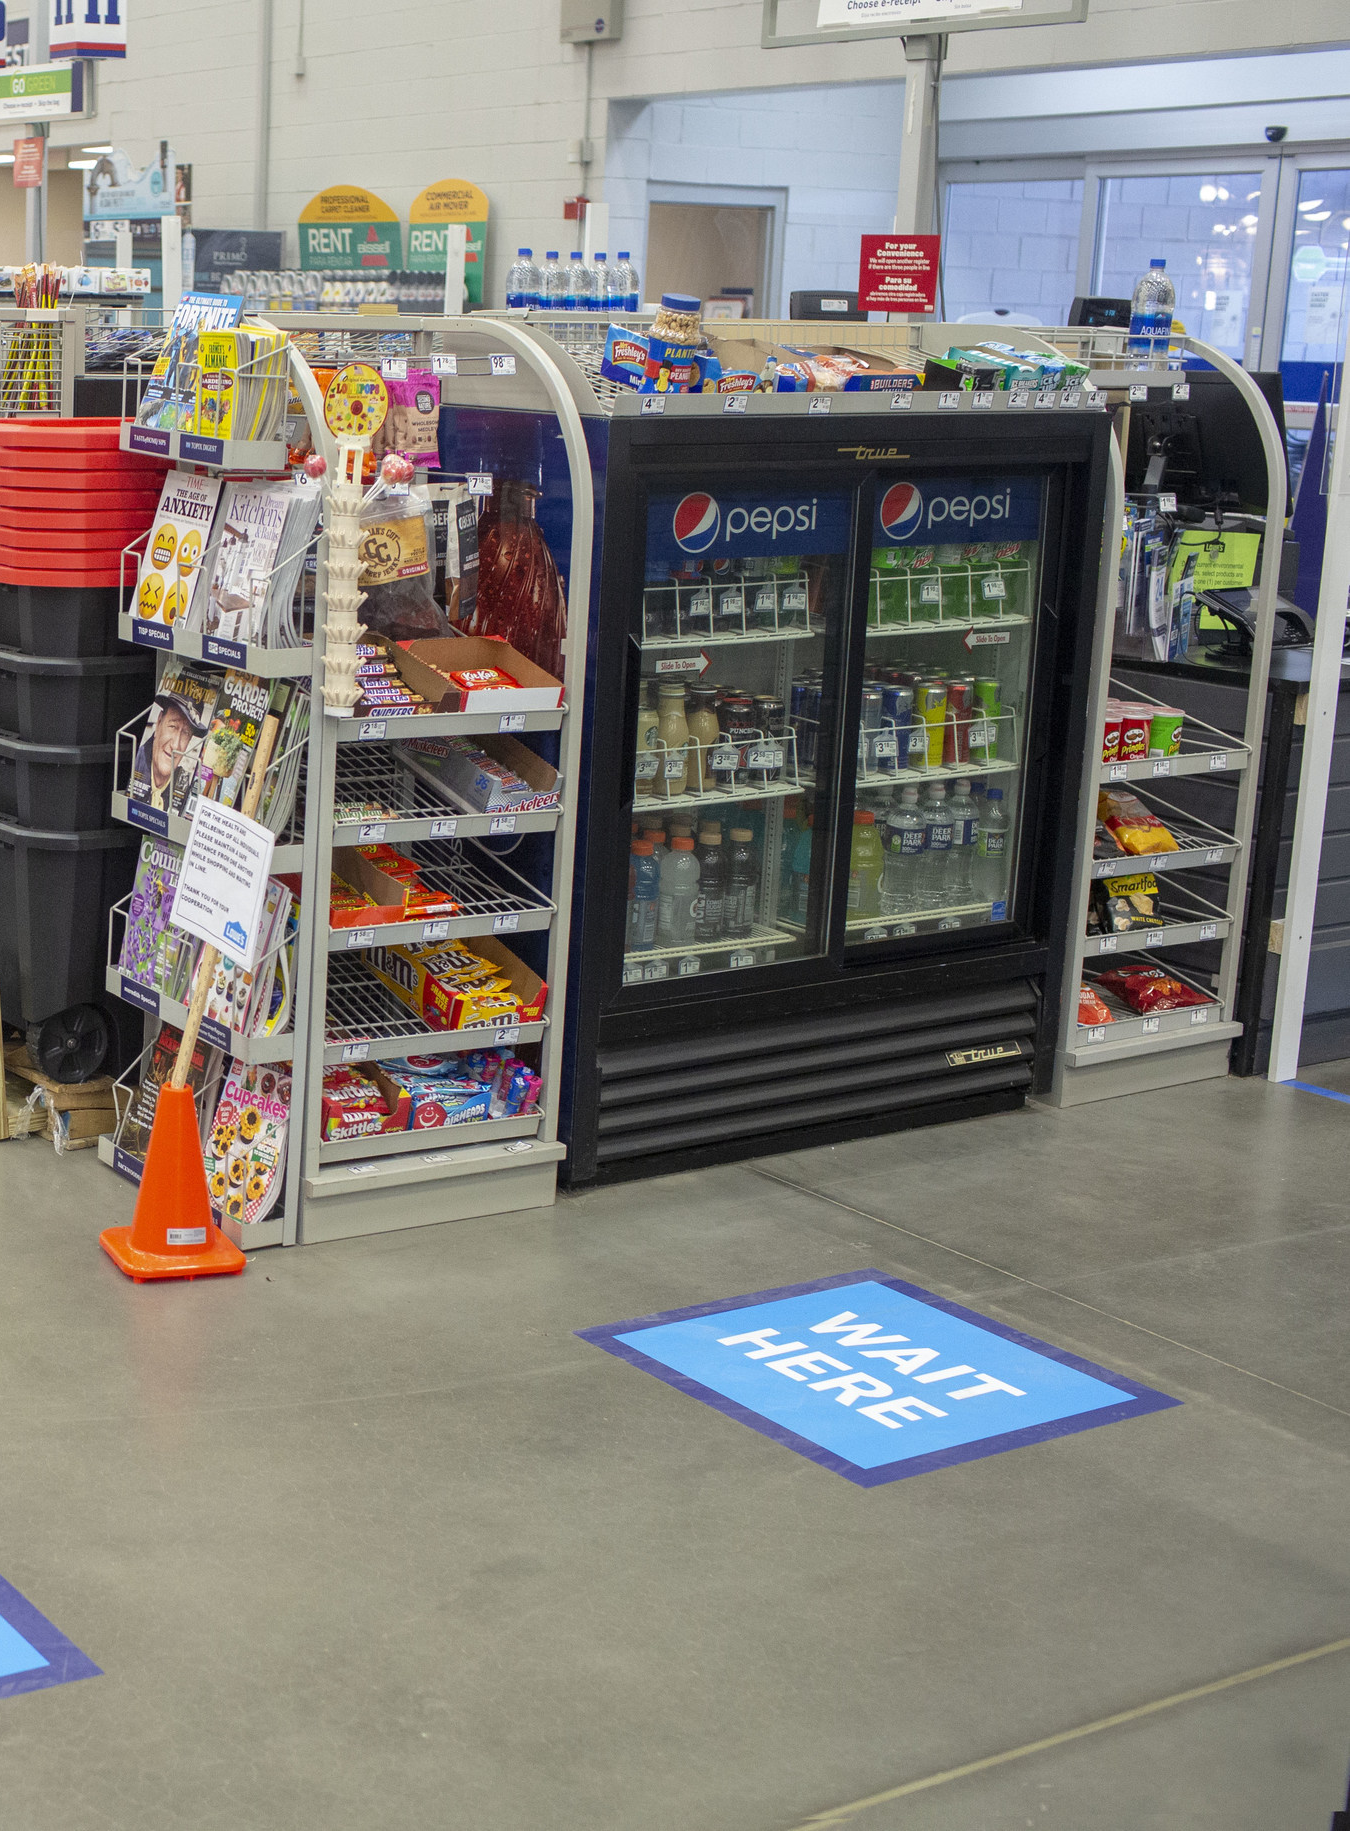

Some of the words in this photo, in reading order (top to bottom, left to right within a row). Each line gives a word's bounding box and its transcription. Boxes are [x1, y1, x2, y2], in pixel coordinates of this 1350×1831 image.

[12, 78, 25, 94] GO
[27, 75, 57, 92] GREEN
[308, 228, 353, 253] RENT
[411, 230, 449, 252] RENT
[885, 242, 898, 250] For
[885, 276, 902, 284] Para
[174, 303, 238, 331] FORTNITE
[204, 354, 228, 368] ALMANAC
[614, 344, 646, 361] Freshley's
[719, 377, 754, 392] Freshley's
[874, 378, 914, 390] BUILDERS
[838, 446, 910, 460] true
[186, 476, 204, 490] TIME
[176, 488, 188, 498] THE
[188, 491, 200, 501] AGE
[200, 494, 208, 502] OF
[265, 496, 285, 509] Dream
[160, 496, 214, 522] ANXIETY
[230, 494, 283, 528] Kitchens
[927, 488, 1010, 529] pepsi
[726, 498, 818, 542] pepsi
[260, 530, 278, 542] Baths
[402, 564, 426, 575] ORIGINAL
[149, 629, 170, 642] SPECIALS
[976, 634, 987, 644] Slide
[988, 634, 993, 642] To
[994, 634, 1006, 643] Open
[218, 646, 241, 660] SPECIALS
[660, 662, 674, 670] Slide
[675, 661, 681, 669] To
[682, 660, 696, 670] Open
[161, 672, 182, 696] John
[184, 678, 217, 705] Wayne
[224, 676, 270, 709] GARDEN
[230, 698, 265, 722] PROJECTS
[1121, 742, 1146, 757] Pringles
[198, 820, 225, 838] WELLBEING
[226, 832, 233, 841] OF
[202, 810, 212, 819] FOR
[212, 814, 220, 824] THE
[222, 818, 239, 832] HEALTH
[196, 830, 214, 843] PLEASE
[214, 838, 236, 854] MAINTAIN
[902, 838, 922, 847] PARK
[903, 832, 923, 840] DEER
[932, 834, 951, 842] PARK
[191, 850, 206, 862] WHILE
[206, 858, 228, 874] SHOPPING
[193, 840, 216, 856] DISTANCE
[218, 852, 230, 862] FROM
[230, 858, 238, 867] ONE
[183, 882, 200, 897] THANK
[200, 892, 210, 902] YOU
[211, 897, 219, 906] FOR
[219, 901, 230, 913] YOUR
[430, 984, 448, 1003] SHARE
[436, 996, 448, 1012] SIZE
[224, 1080, 287, 1119] Cupcakes
[444, 1104, 486, 1126] AIRHEADS
[330, 1120, 382, 1141] Skittles
[808, 1310, 1028, 1400] WAIT
[716, 1328, 949, 1430] HERE
